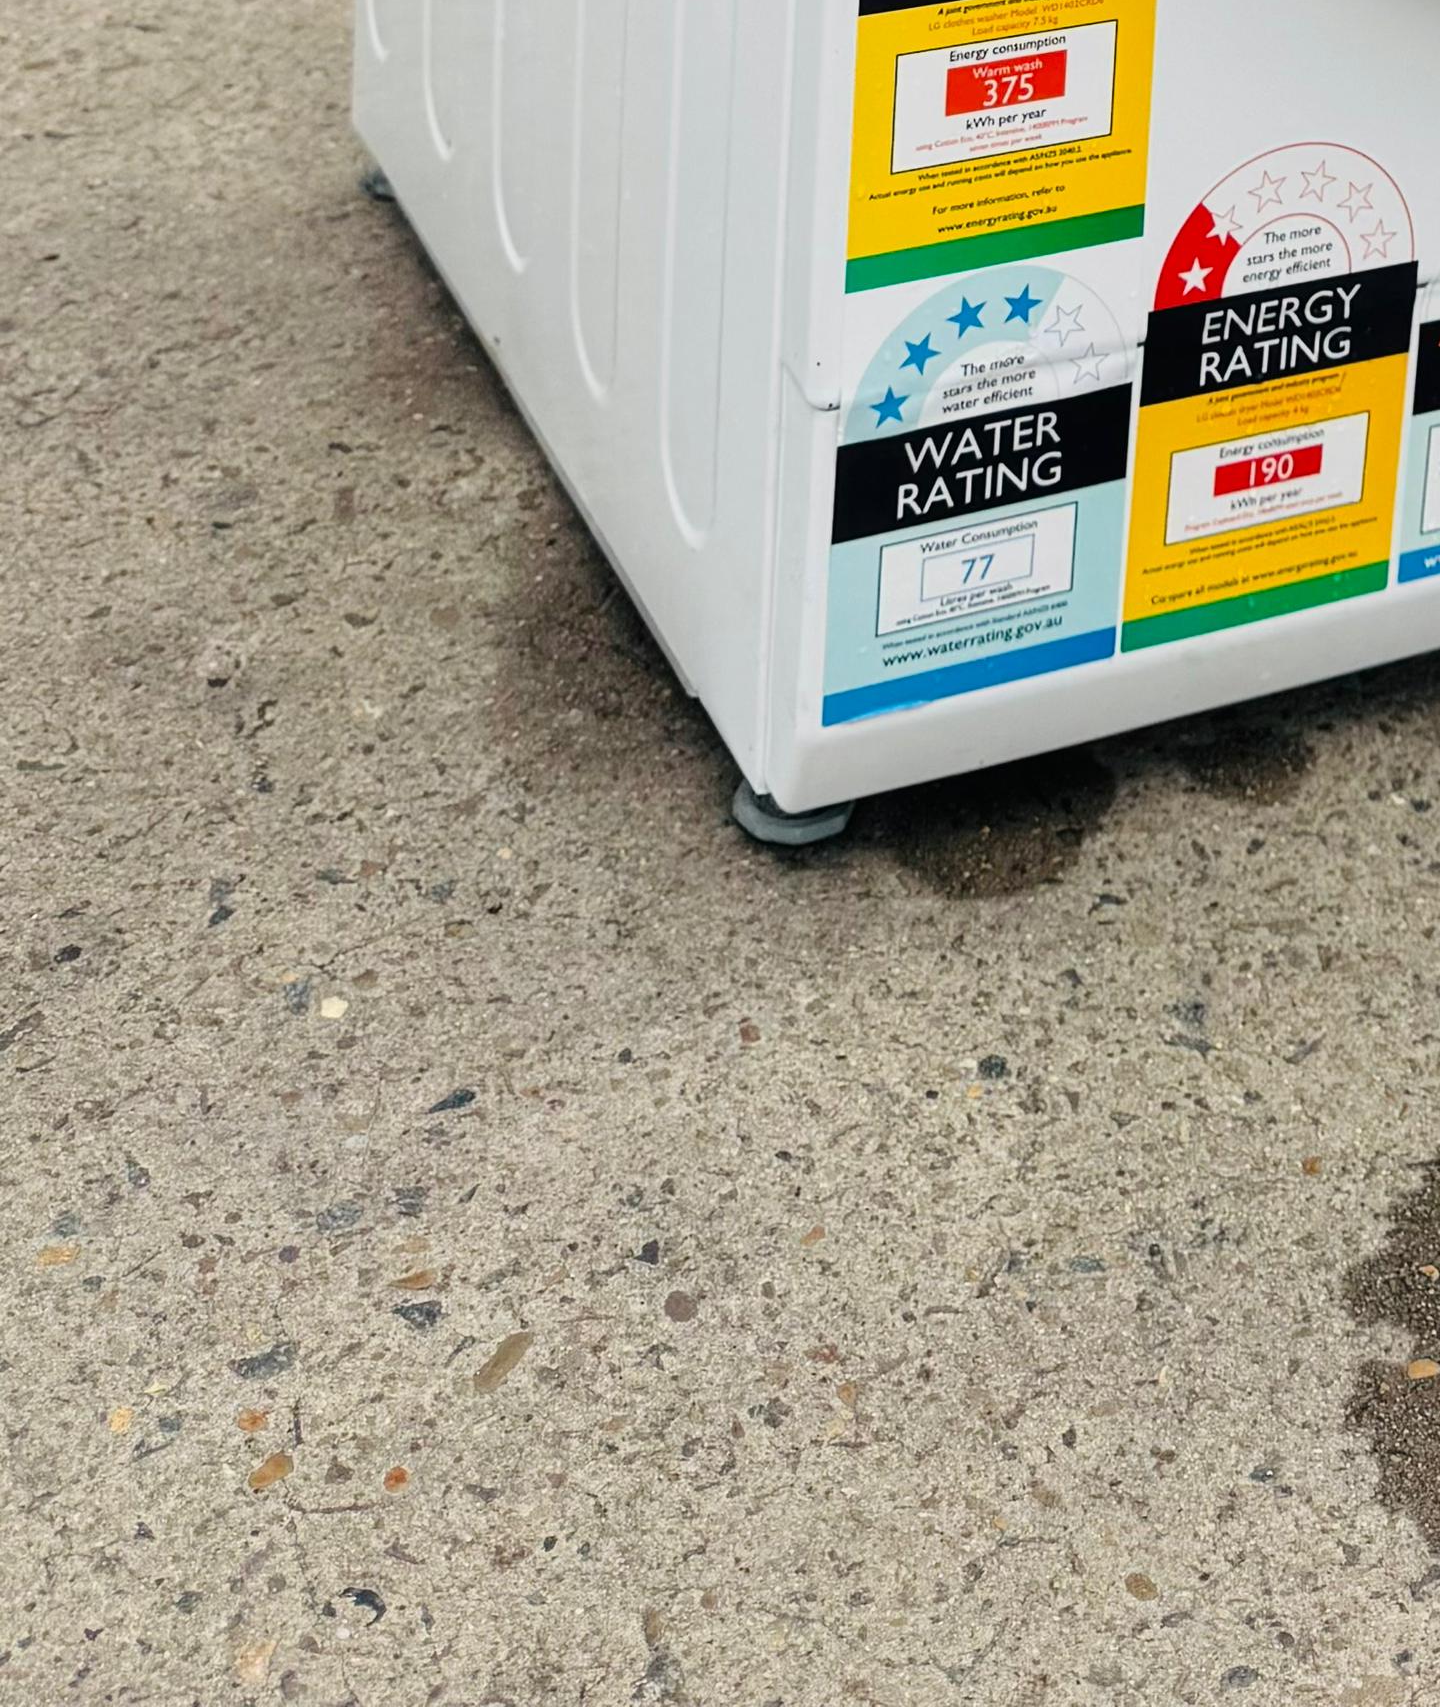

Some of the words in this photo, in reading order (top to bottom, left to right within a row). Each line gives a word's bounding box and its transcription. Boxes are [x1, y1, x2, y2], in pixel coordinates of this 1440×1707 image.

[950, 49, 989, 62] Energy
[992, 35, 1066, 55] consumption
[973, 65, 1011, 79] Warm
[1014, 59, 1042, 71] wash
[983, 74, 1034, 107] 375
[966, 118, 995, 130] kWh
[999, 115, 1018, 127] per
[1022, 109, 1047, 123] year
[933, 206, 947, 215] For
[950, 202, 974, 211] more
[1032, 187, 1052, 196] refer
[1264, 231, 1286, 244] The
[1290, 225, 1321, 239] more
[1247, 252, 1275, 266] stars
[1279, 247, 1297, 260] the
[1301, 241, 1333, 255] more
[1243, 267, 1282, 283] energy
[1286, 257, 1331, 274] efficient
[1202, 284, 1362, 345] ENERGY
[960, 362, 986, 376] The
[989, 354, 1024, 371] more
[1200, 326, 1352, 387] RATING
[943, 384, 973, 398] stars
[977, 377, 997, 391] the
[1001, 369, 1036, 384] more
[942, 399, 980, 414] water
[983, 386, 1033, 404] efficient
[905, 412, 1061, 474] WATER
[1220, 445, 1253, 458] Energy
[1250, 454, 1294, 486] 190
[896, 452, 1062, 520] RATING
[920, 537, 956, 554] Water
[961, 519, 1038, 545] Consumption
[962, 554, 995, 584] 77
[882, 616, 1062, 667] www.waterrating.gov.au
